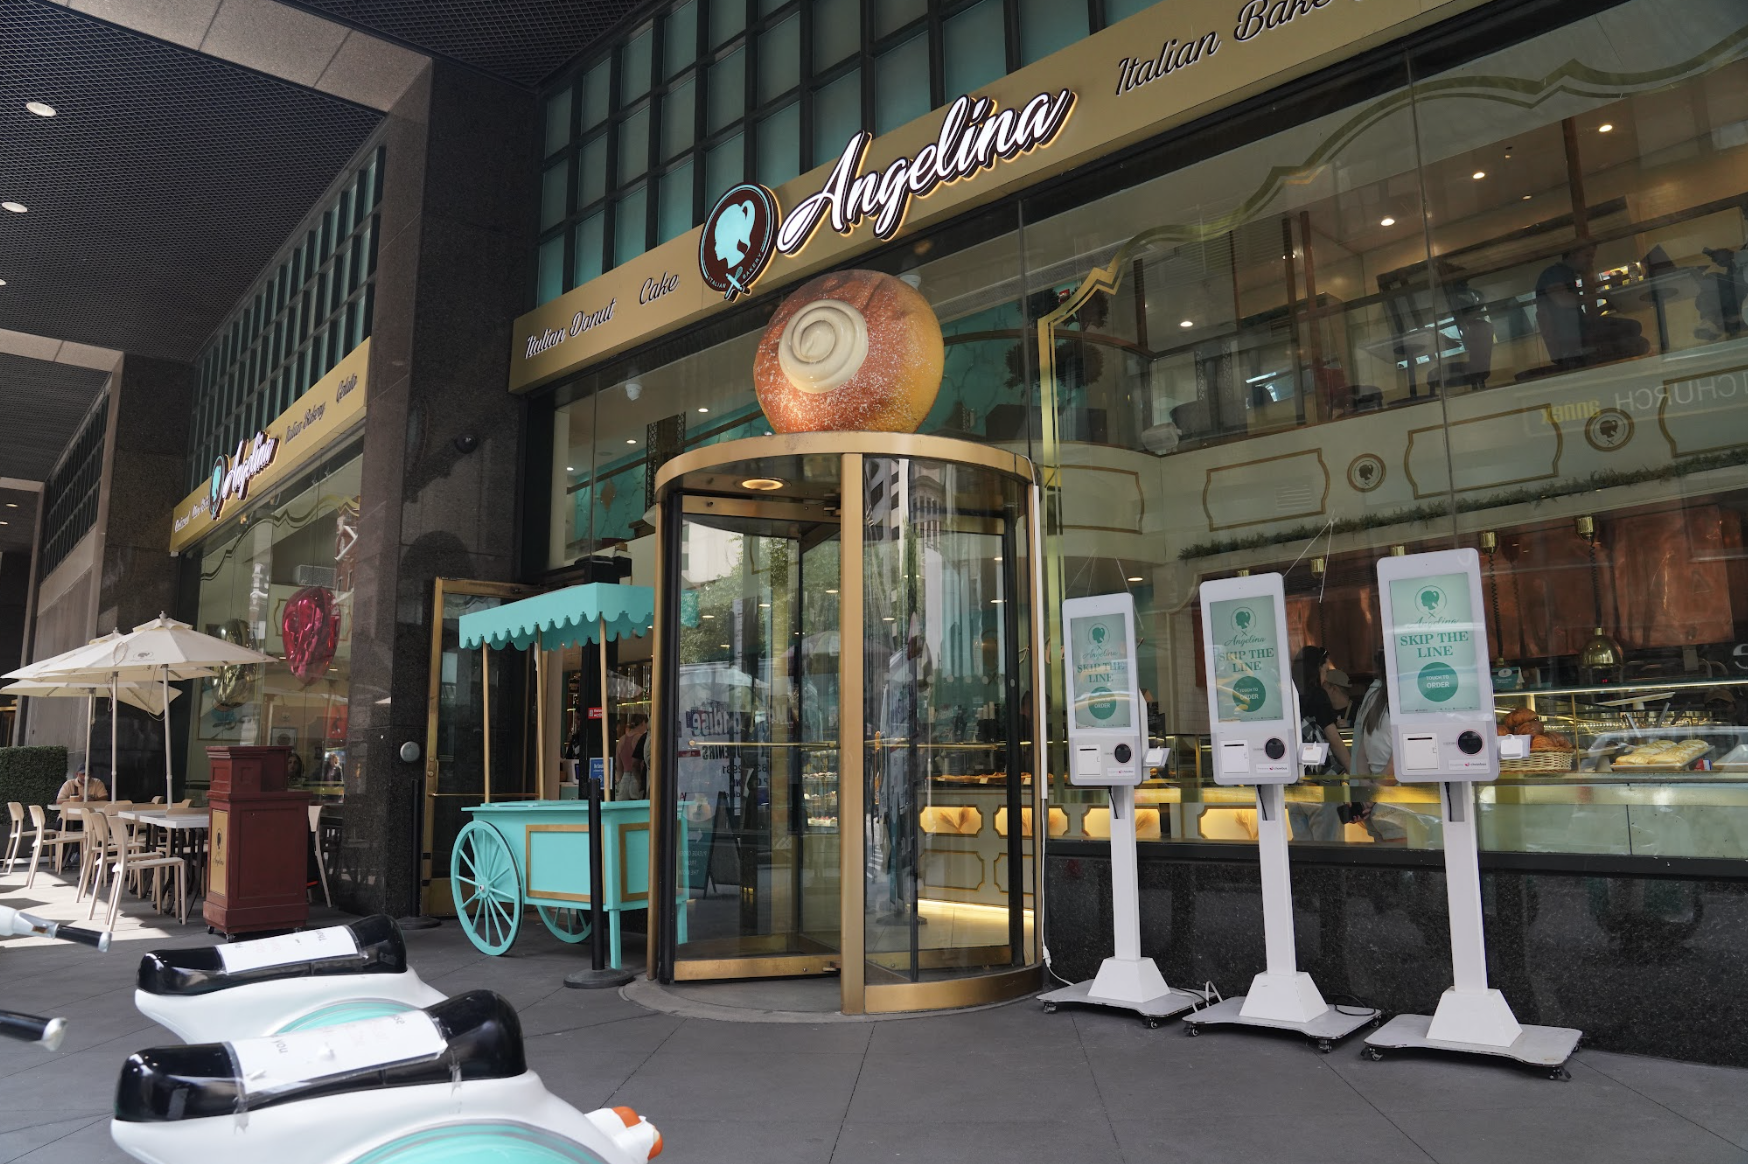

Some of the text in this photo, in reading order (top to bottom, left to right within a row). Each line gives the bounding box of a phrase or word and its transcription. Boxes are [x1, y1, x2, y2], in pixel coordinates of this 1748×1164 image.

[1115, 31, 1221, 96] Italian
[777, 88, 1071, 254] Angelina
[639, 271, 680, 306] Cake
[525, 298, 617, 359] Italian Donut
[1400, 631, 1469, 646] SKIP THE
[1219, 648, 1274, 661] SKIP THE
[1417, 645, 1453, 658] LINE
[1077, 663, 1100, 673] SKIP
[1233, 661, 1262, 672] LINE
[1089, 673, 1113, 683] LINE
